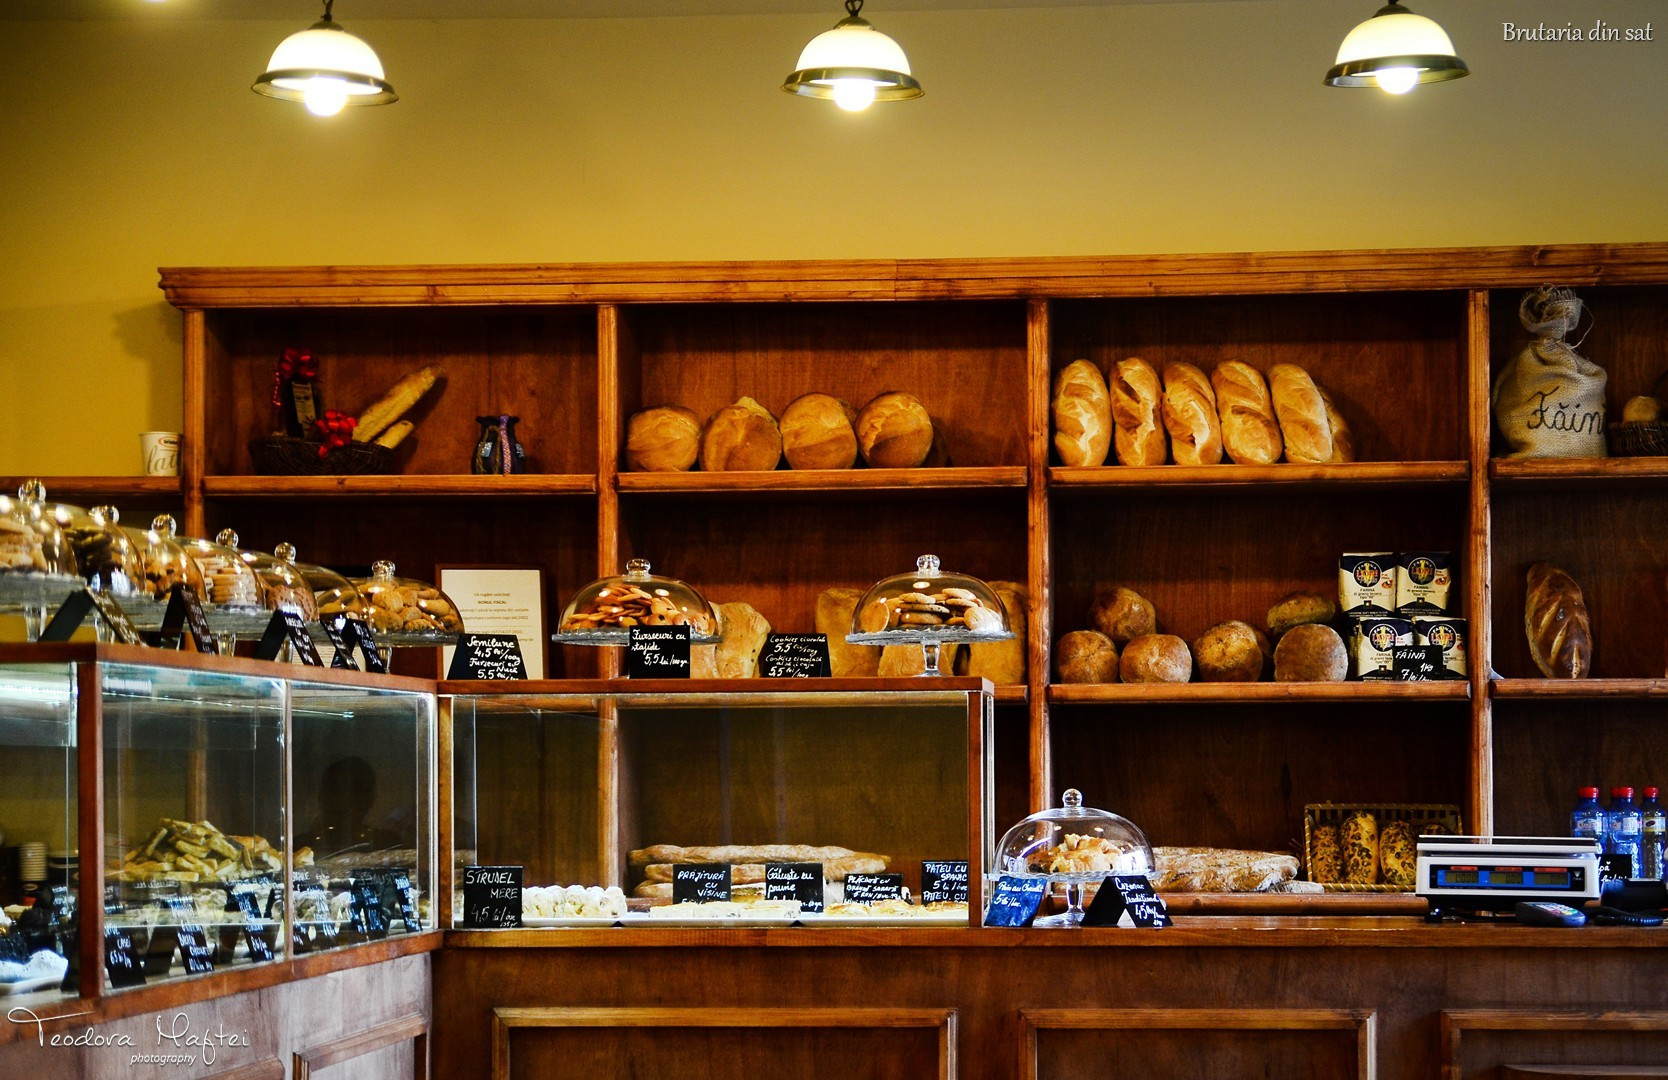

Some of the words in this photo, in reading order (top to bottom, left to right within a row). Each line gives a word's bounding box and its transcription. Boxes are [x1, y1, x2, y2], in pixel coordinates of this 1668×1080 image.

[467, 635, 515, 648] Semilune
[474, 647, 492, 658] 4,5
[925, 863, 951, 873] PATEU
[955, 864, 967, 872] CU
[932, 880, 941, 890] 5
[490, 888, 518, 899] MERE
